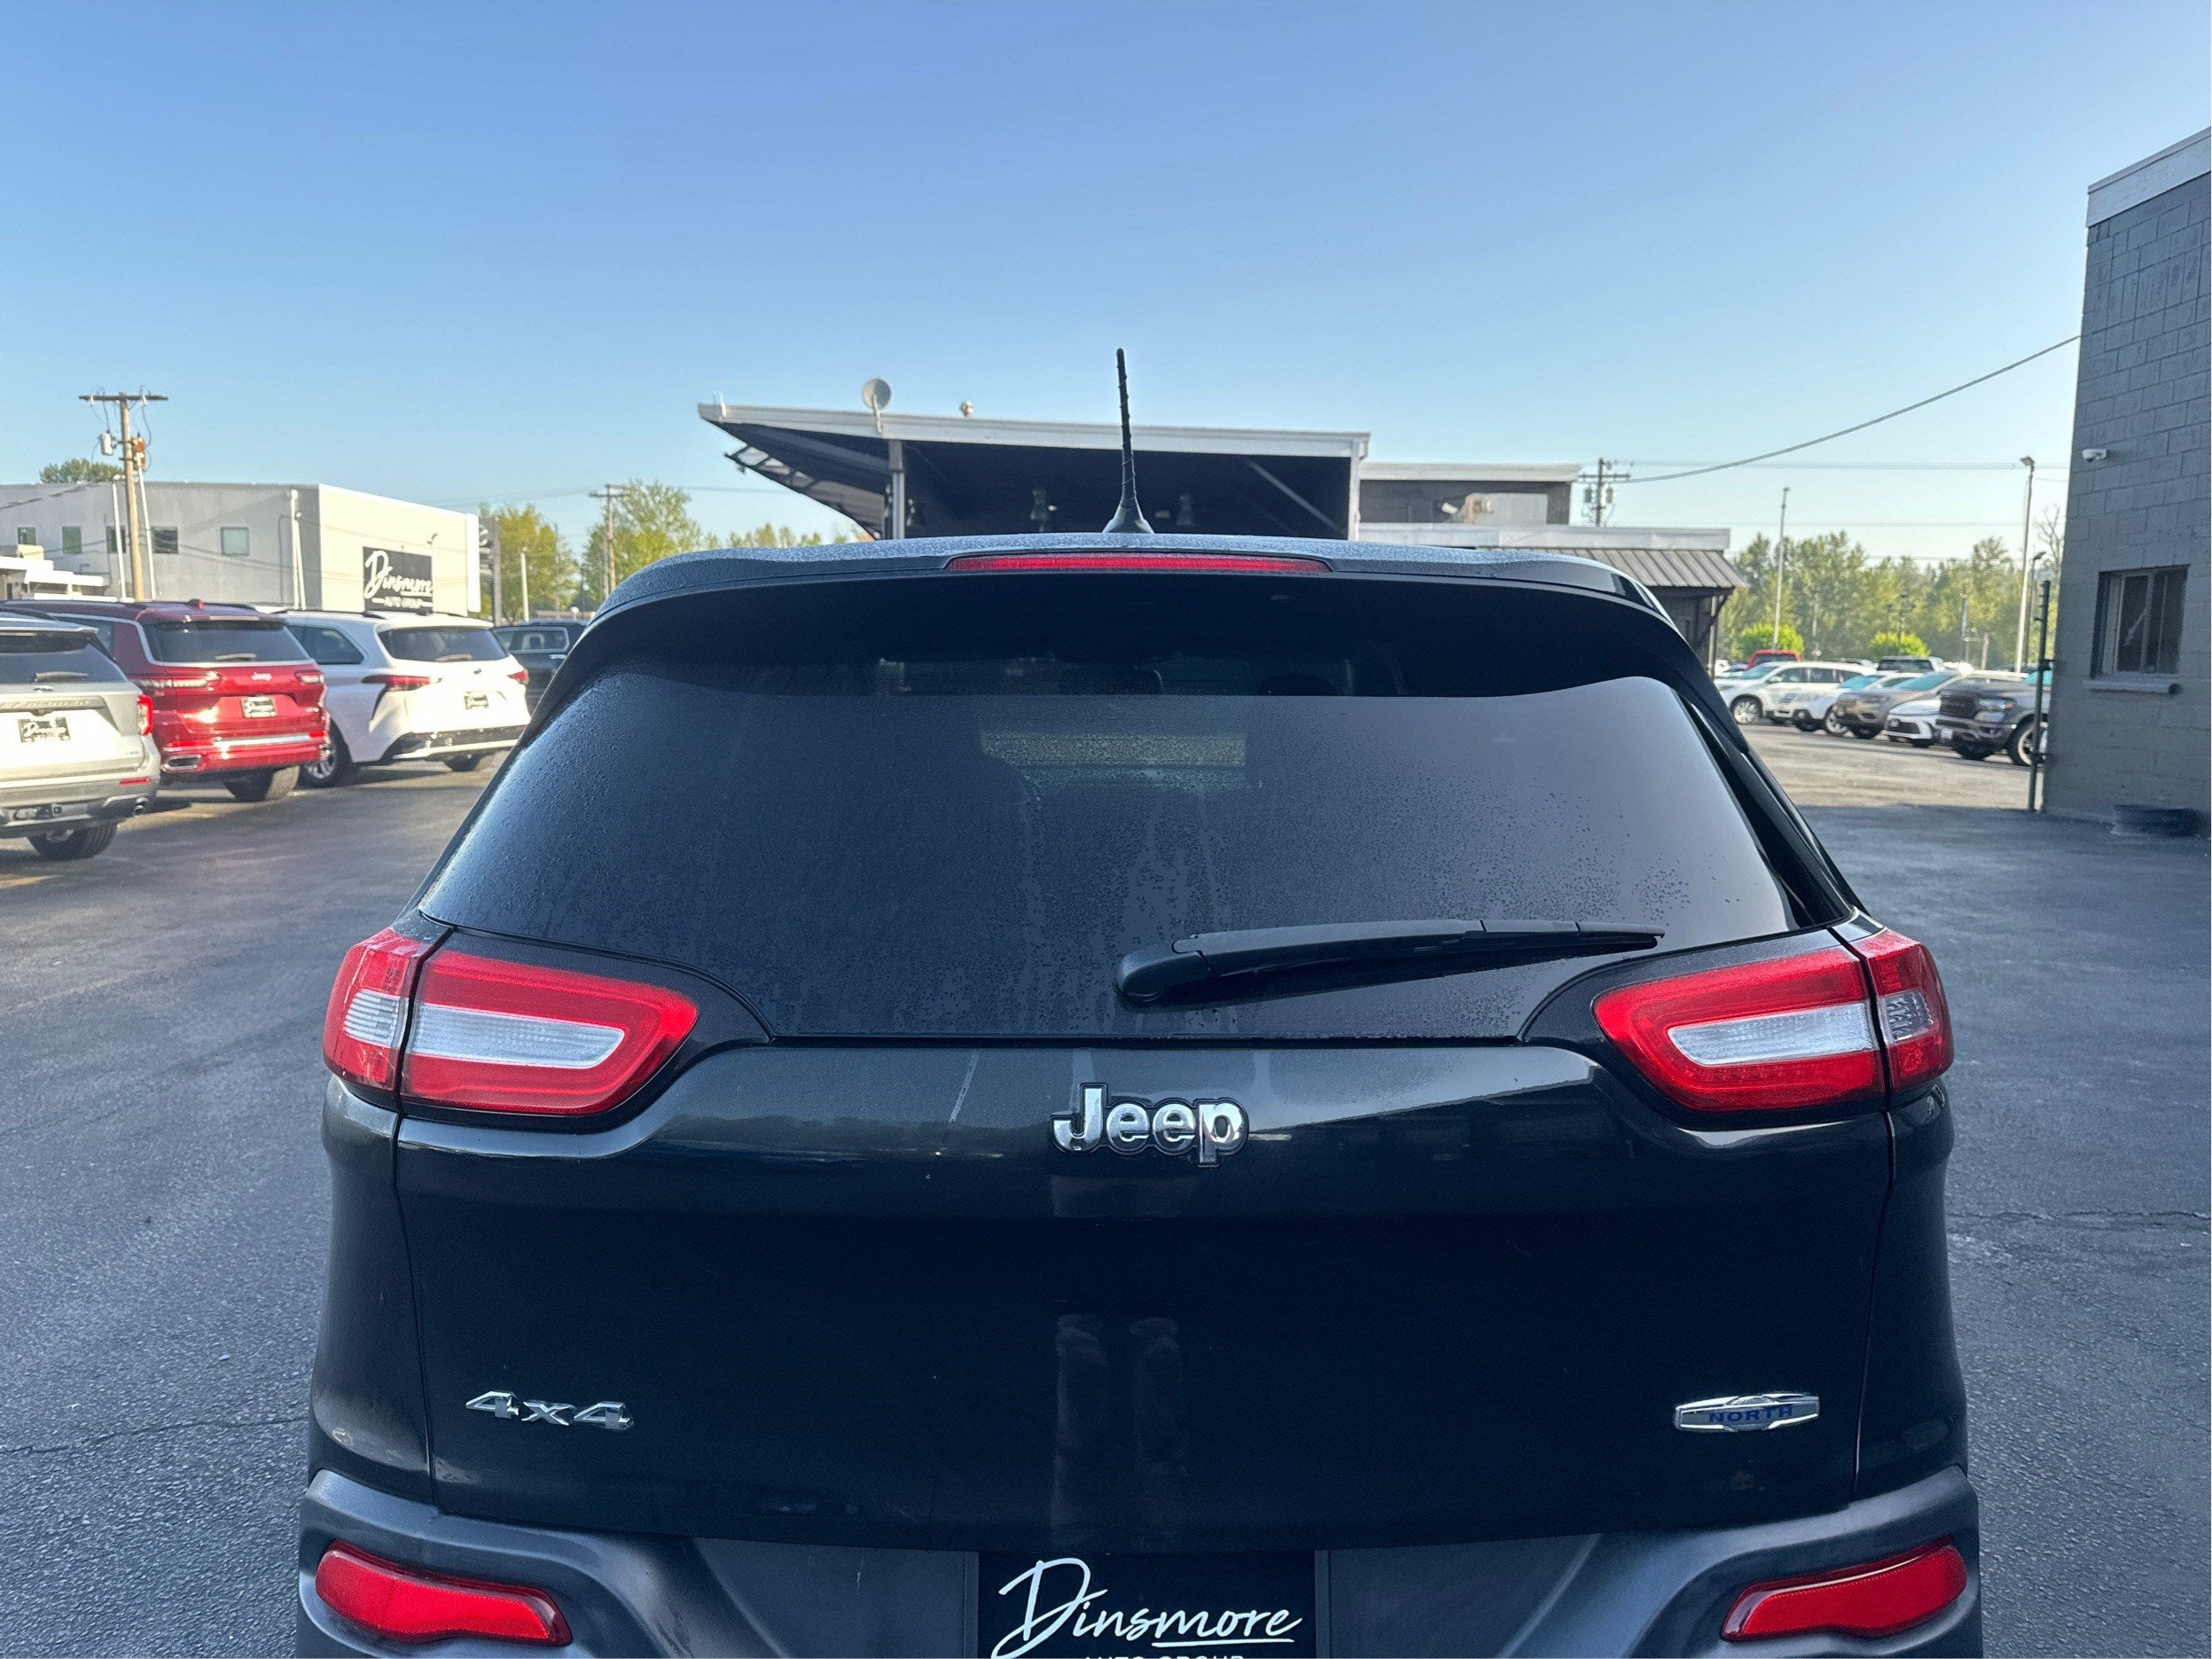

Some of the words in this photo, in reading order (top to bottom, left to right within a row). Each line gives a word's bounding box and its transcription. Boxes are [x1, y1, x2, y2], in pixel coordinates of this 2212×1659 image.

[1050, 1083, 1249, 1168] Jeep
[465, 1390, 633, 1430] 4x4
[1708, 1405, 1793, 1423] NORTH
[990, 1557, 1302, 1659] Dinsmore
